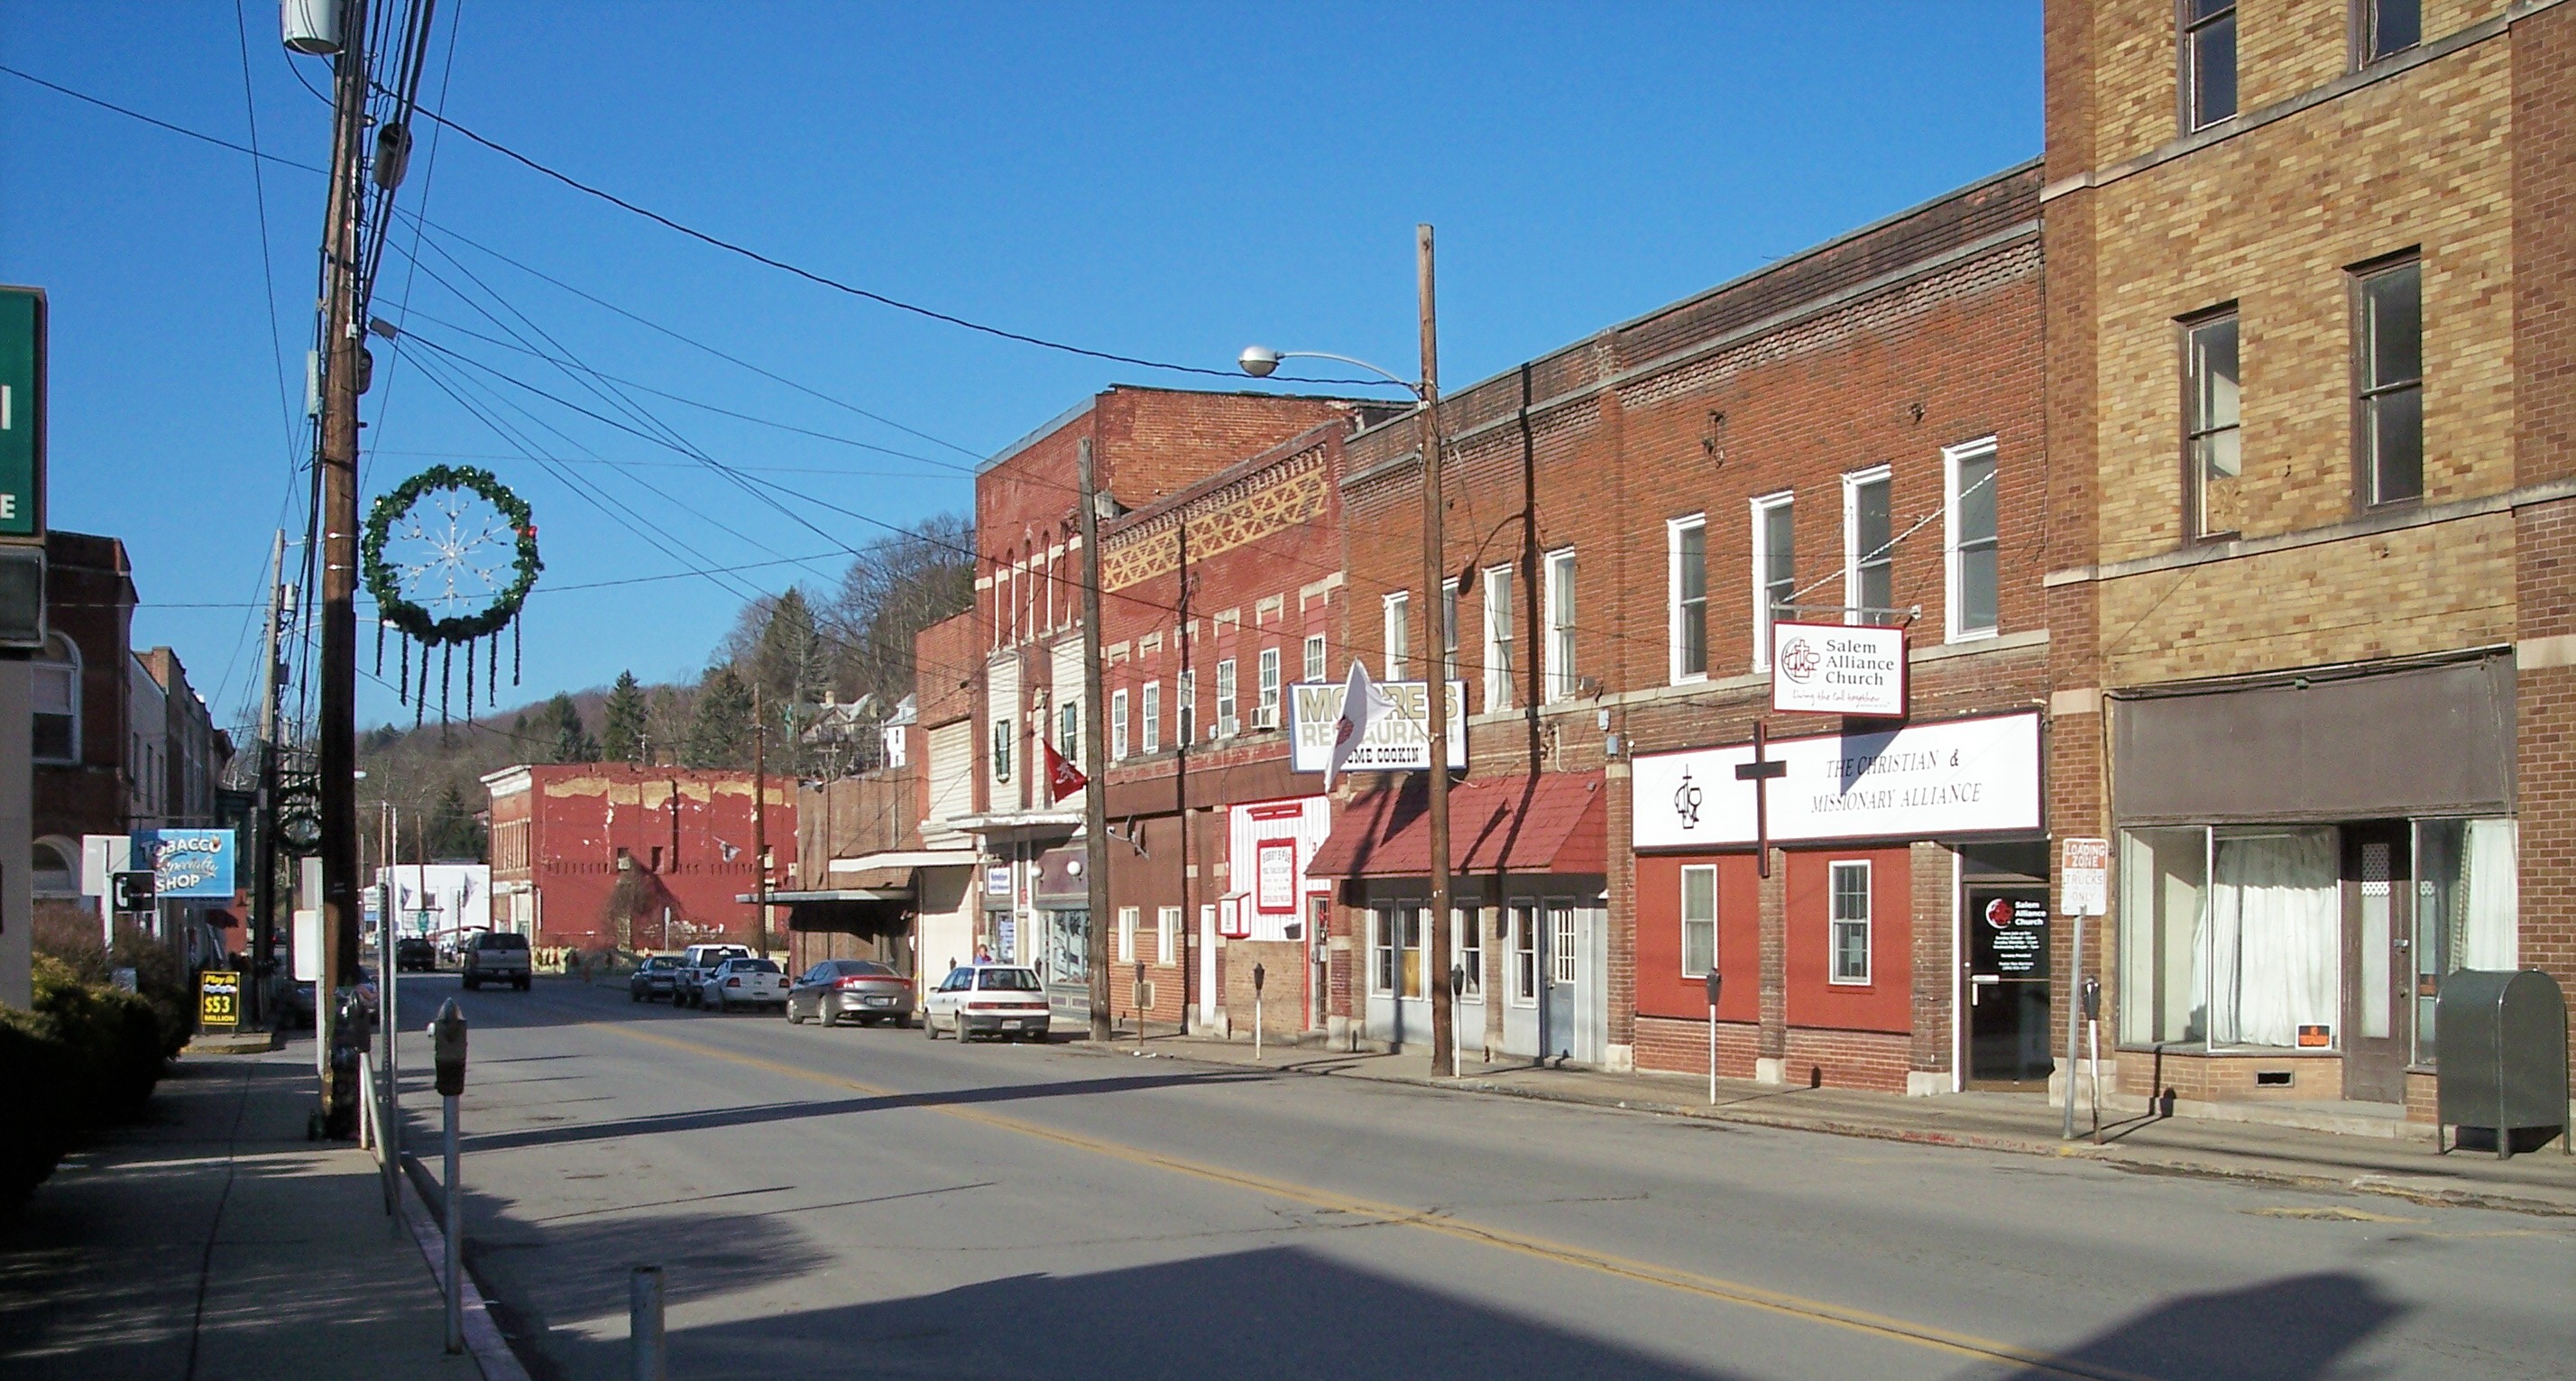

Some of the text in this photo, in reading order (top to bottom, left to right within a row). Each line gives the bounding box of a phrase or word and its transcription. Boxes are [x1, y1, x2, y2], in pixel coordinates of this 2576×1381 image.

[1826, 640, 1877, 654] Salem
[1826, 656, 1895, 670] Alliance
[1825, 671, 1884, 686] Church
[1826, 749, 1959, 778] THE CHRISTIAN &
[1811, 782, 1983, 814] MISSIONARY ALLIANCE
[141, 837, 222, 863] TOBACCO
[2065, 843, 2105, 856] LOADING
[2072, 855, 2099, 867] ZONE
[156, 874, 200, 892] SHOP
[2065, 874, 2102, 885] TRUCKS
[205, 975, 225, 985] Play
[205, 996, 231, 1013] $53
